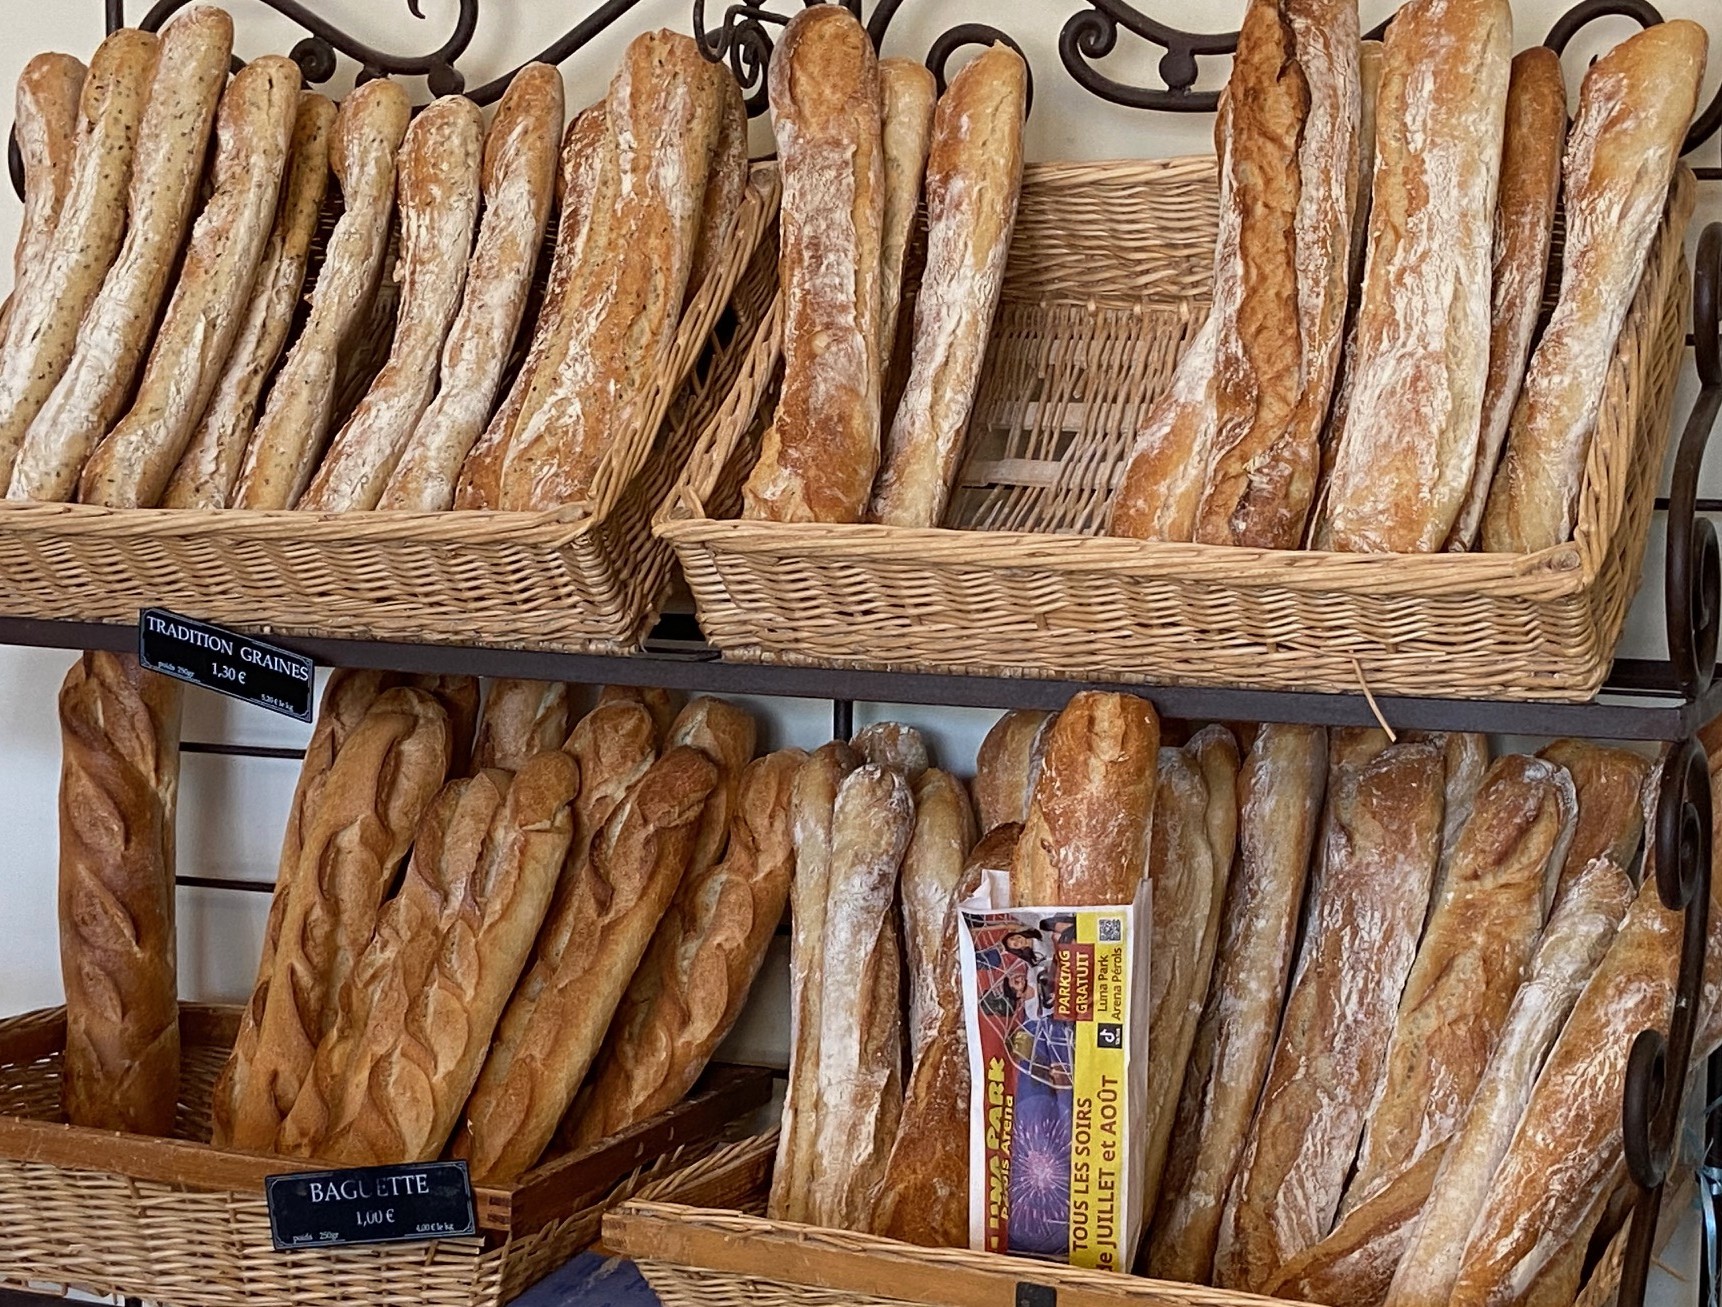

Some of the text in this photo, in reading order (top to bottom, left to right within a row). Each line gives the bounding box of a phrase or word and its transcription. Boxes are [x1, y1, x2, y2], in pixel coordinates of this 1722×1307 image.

[146, 616, 309, 682] TRADITION GRAINES
[211, 662, 247, 685] 1,30 €
[1058, 950, 1071, 1015] PARKING
[1075, 952, 1089, 1014] GRATUIT
[1097, 954, 1109, 1012] Luna Park
[1111, 947, 1122, 982] Pérols
[1111, 984, 1122, 1021] Arena
[986, 1056, 1005, 1150] PARK
[1000, 1095, 1013, 1155] Arena
[1097, 1075, 1118, 1136] AOÛT
[1072, 1098, 1092, 1252] TOUS LES SOIRS
[1103, 1140, 1116, 1161] et
[309, 1173, 430, 1202] BAGUETTE
[356, 1208, 395, 1227] 1,00 €
[1096, 1167, 1117, 1249] JUILLET
